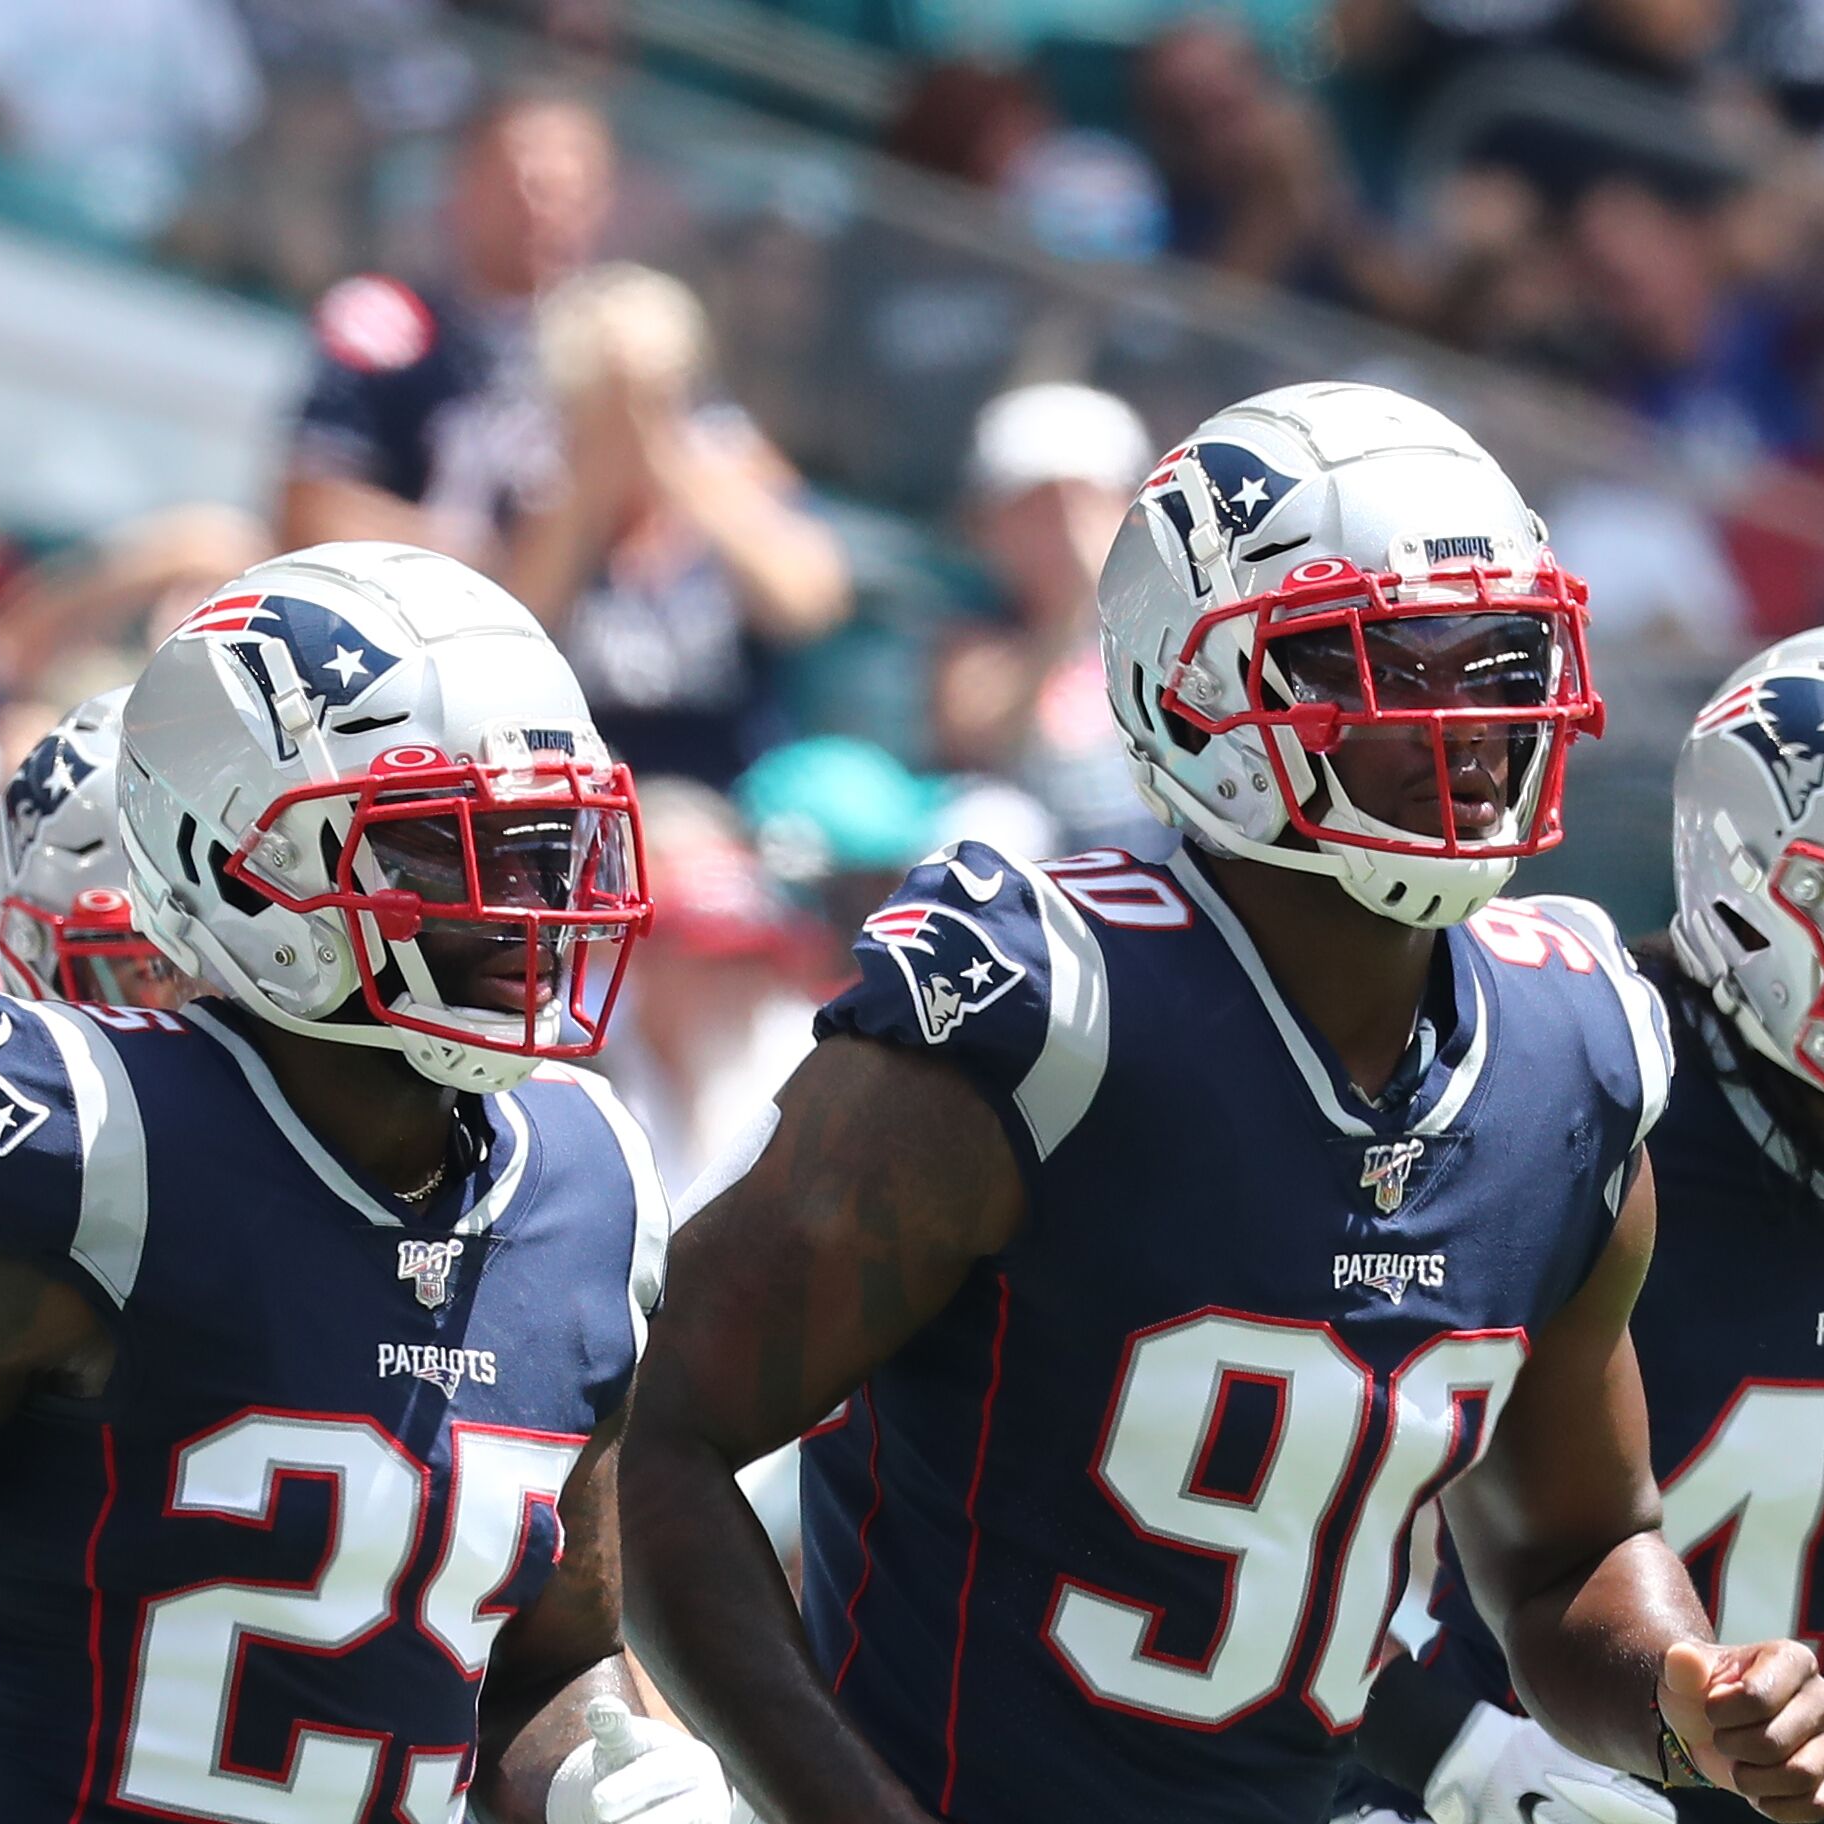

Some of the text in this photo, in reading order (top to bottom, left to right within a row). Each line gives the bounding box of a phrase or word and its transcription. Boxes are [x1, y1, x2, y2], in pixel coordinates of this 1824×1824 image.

[1333, 1253, 1446, 1289] PATRIOTS
[377, 1343, 497, 1385] PATRIOTS
[1039, 1304, 1529, 1736] 90
